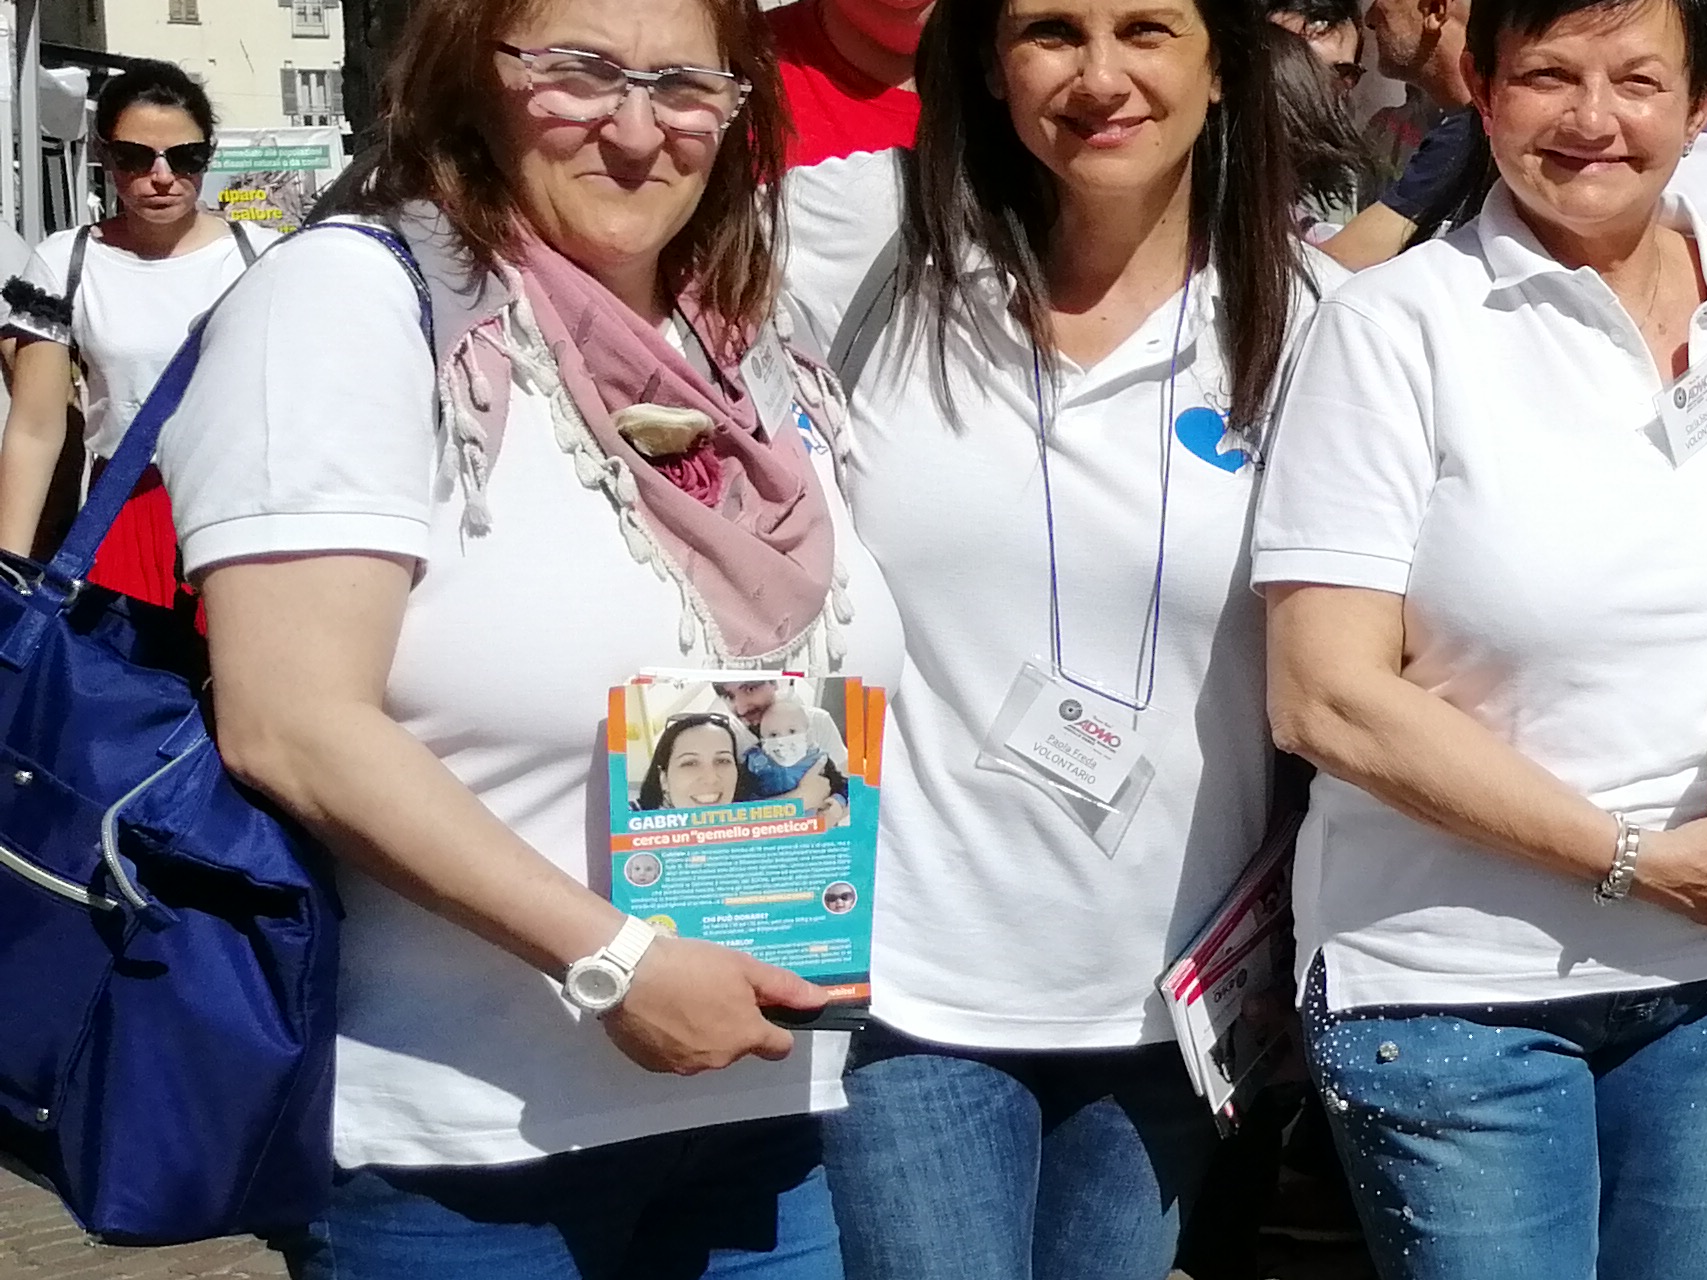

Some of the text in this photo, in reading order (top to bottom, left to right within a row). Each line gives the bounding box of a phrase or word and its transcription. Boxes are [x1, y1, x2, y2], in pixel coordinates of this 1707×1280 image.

[218, 188, 267, 204] riparo
[230, 207, 283, 221] calore
[1033, 742, 1096, 785] VOLONTARIO
[629, 803, 797, 832] GABRY LITTLE HERO
[633, 832, 671, 847] cerca
[672, 830, 689, 844] un
